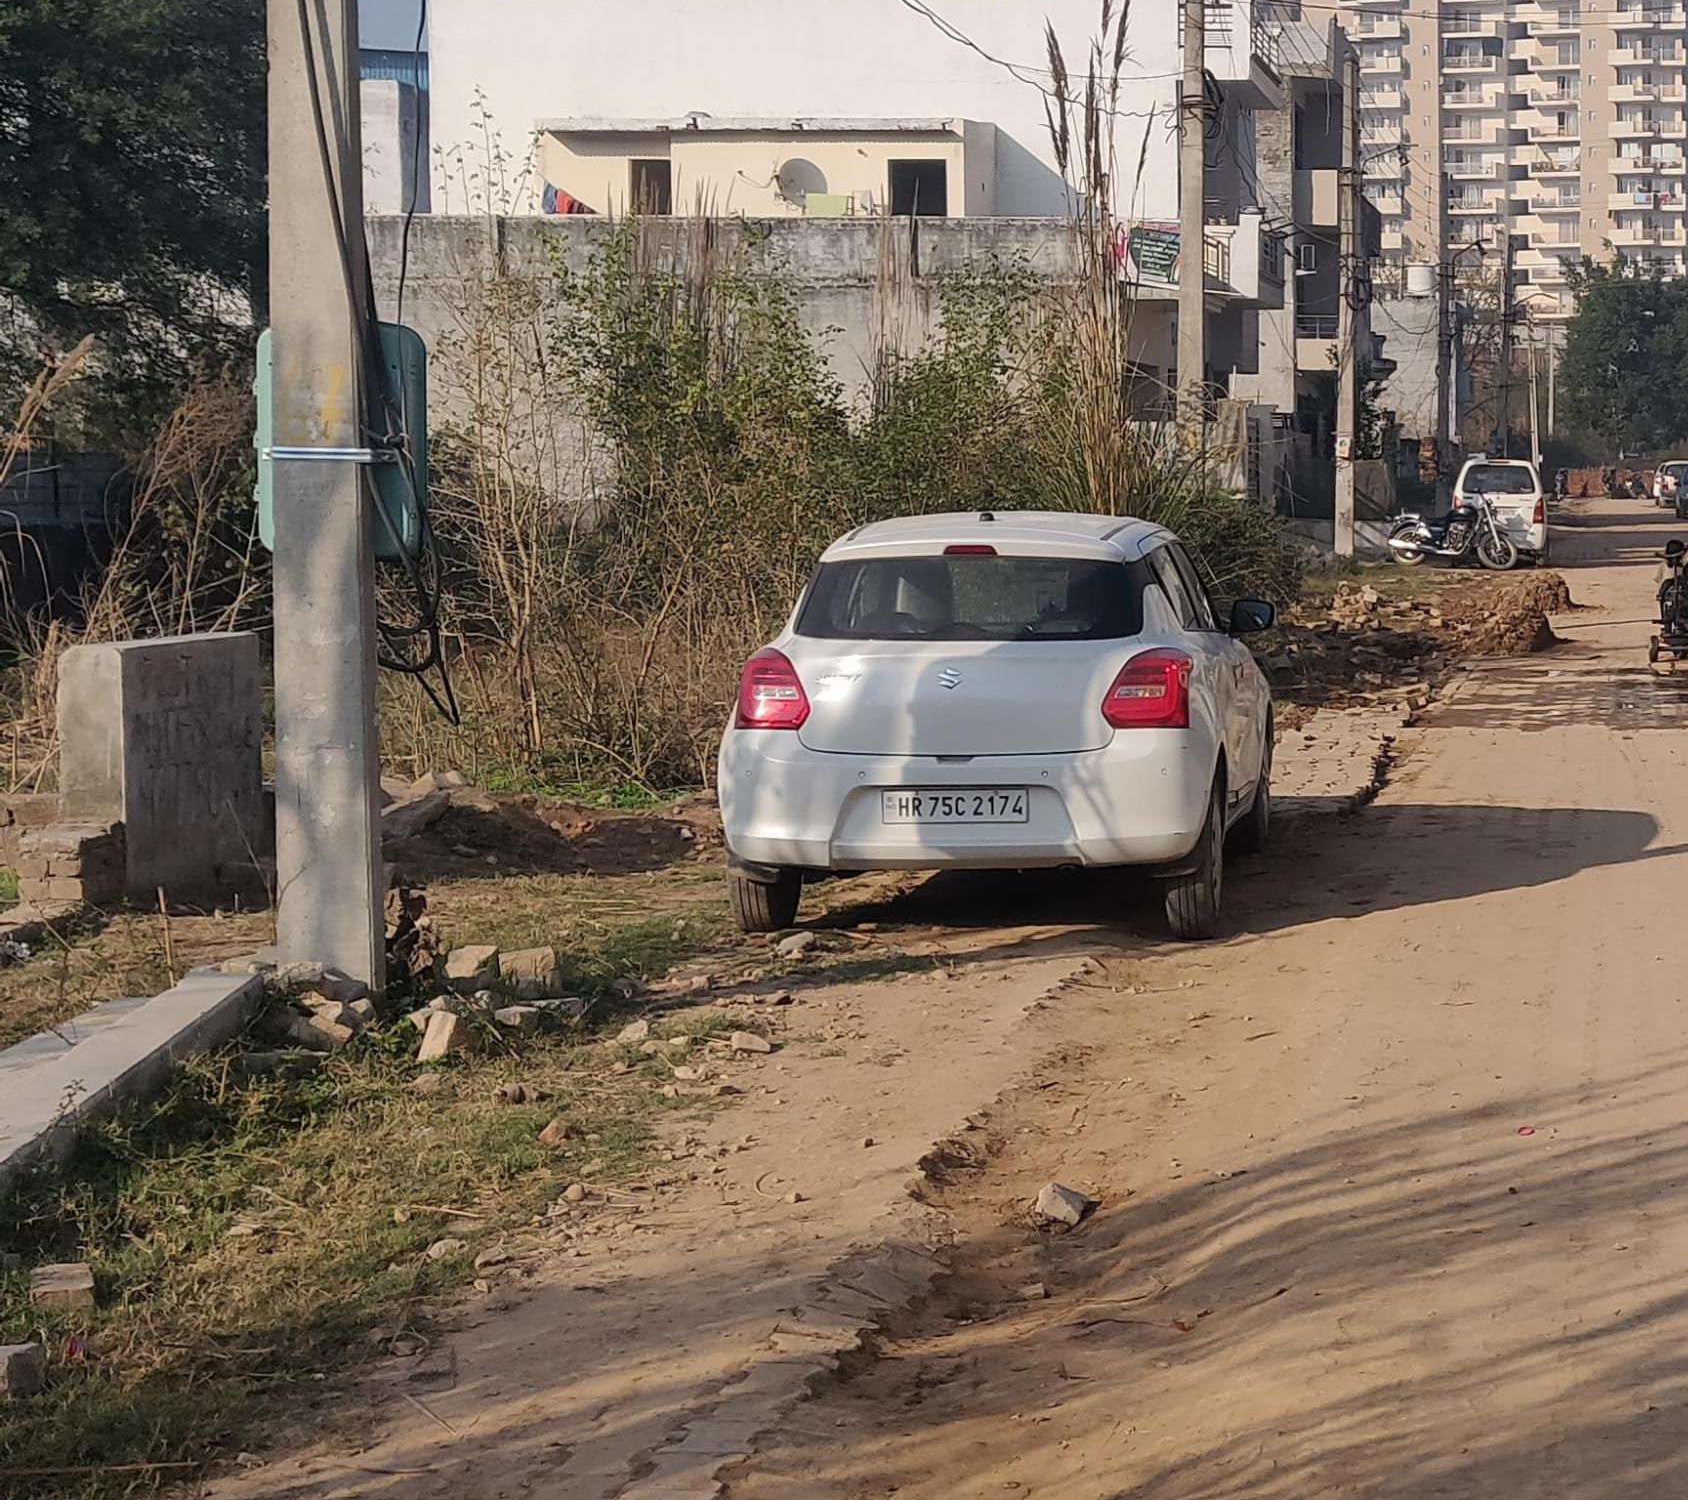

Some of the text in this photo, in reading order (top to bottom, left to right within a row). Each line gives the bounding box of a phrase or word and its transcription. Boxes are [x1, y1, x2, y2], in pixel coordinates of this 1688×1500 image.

[898, 796, 922, 817] HR
[928, 796, 967, 816] 75C
[972, 795, 1024, 816] 2174
